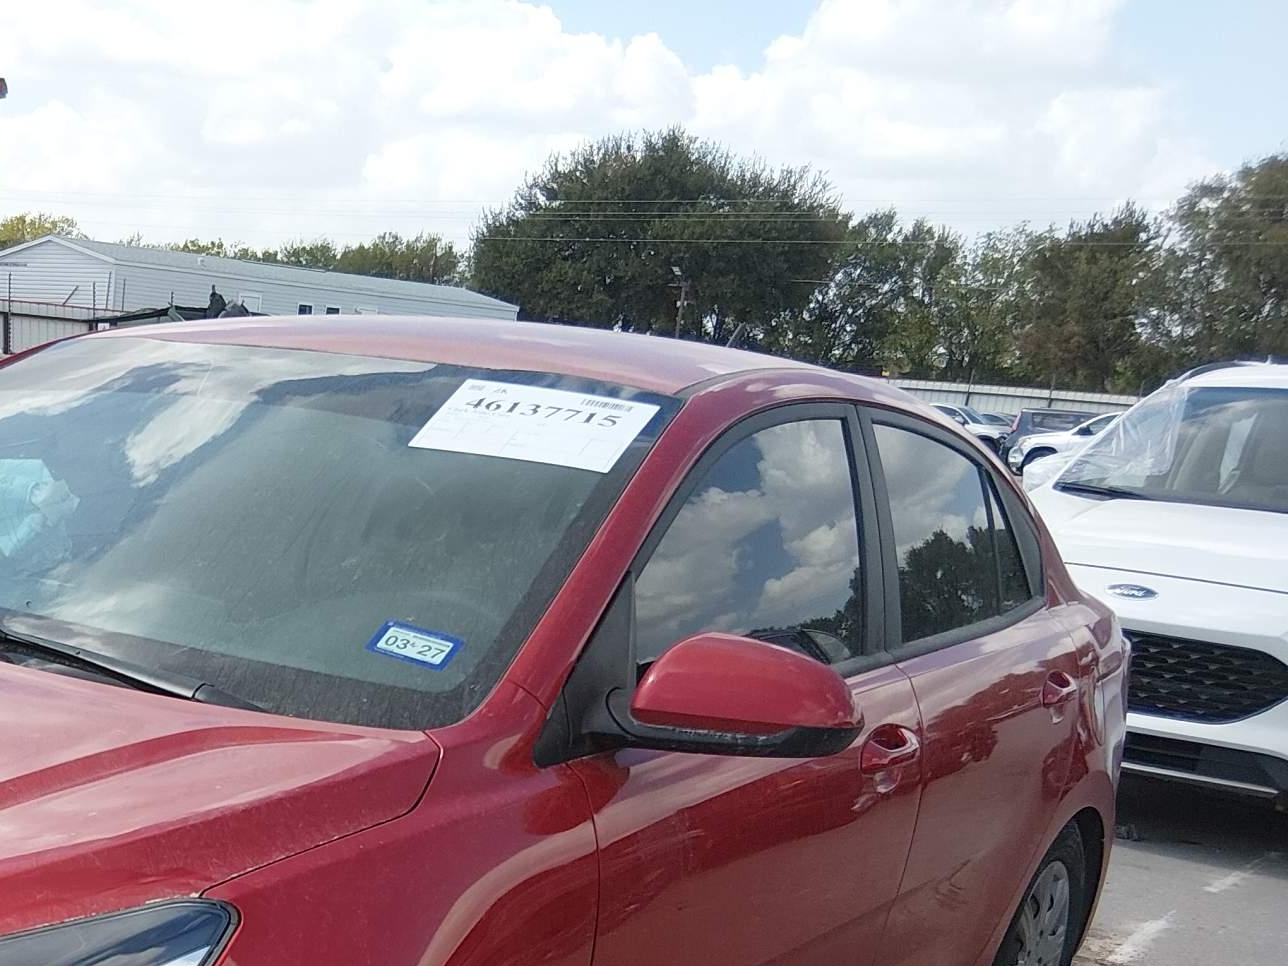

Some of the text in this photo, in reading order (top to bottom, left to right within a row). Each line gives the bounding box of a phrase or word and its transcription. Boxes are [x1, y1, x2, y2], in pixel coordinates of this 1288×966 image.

[465, 397, 624, 428] 46137715
[384, 635, 446, 659] 03 27
